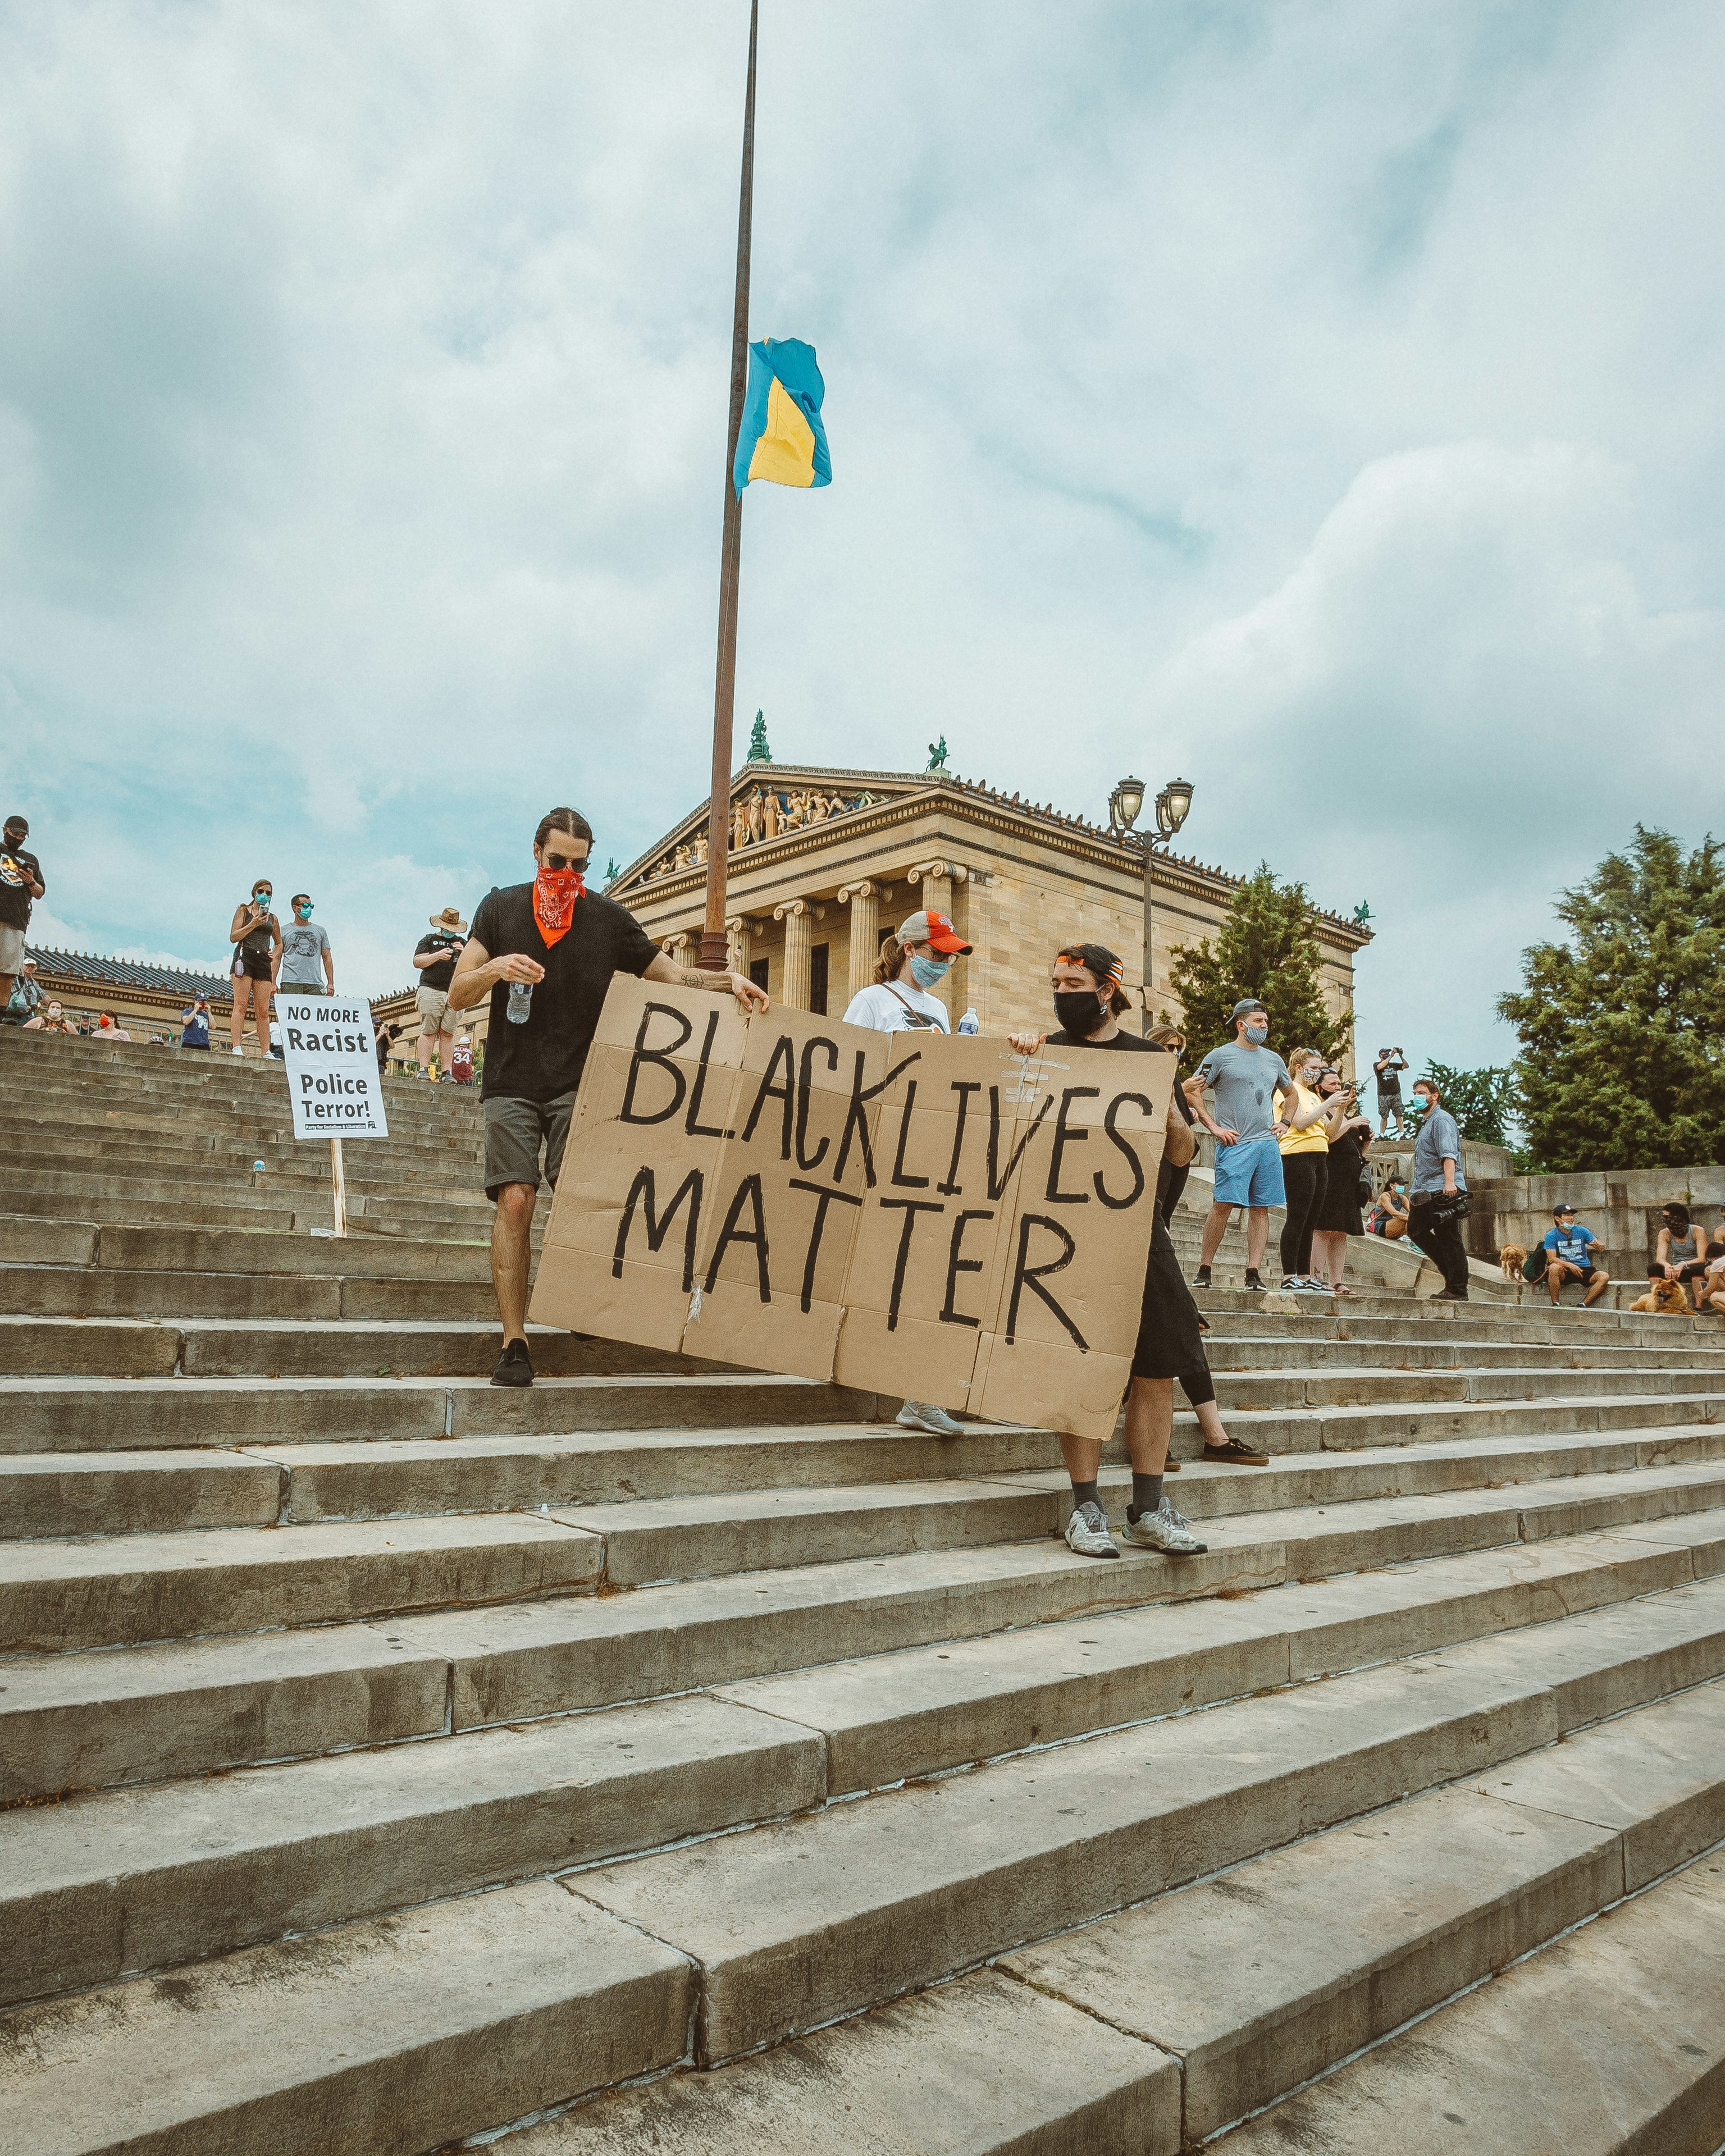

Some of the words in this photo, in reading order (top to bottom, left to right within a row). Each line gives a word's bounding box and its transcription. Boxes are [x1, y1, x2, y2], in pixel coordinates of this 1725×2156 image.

[288, 1006, 311, 1021] NO
[316, 1008, 359, 1023] MORE
[287, 1029, 368, 1053] Racist
[453, 1052, 470, 1065] 34
[300, 1074, 367, 1095] Police
[302, 1100, 370, 1118] Terror!
[619, 1002, 921, 1187] BLACK
[891, 1080, 1153, 1211] LIVES
[611, 1166, 1090, 1353] MATTER
